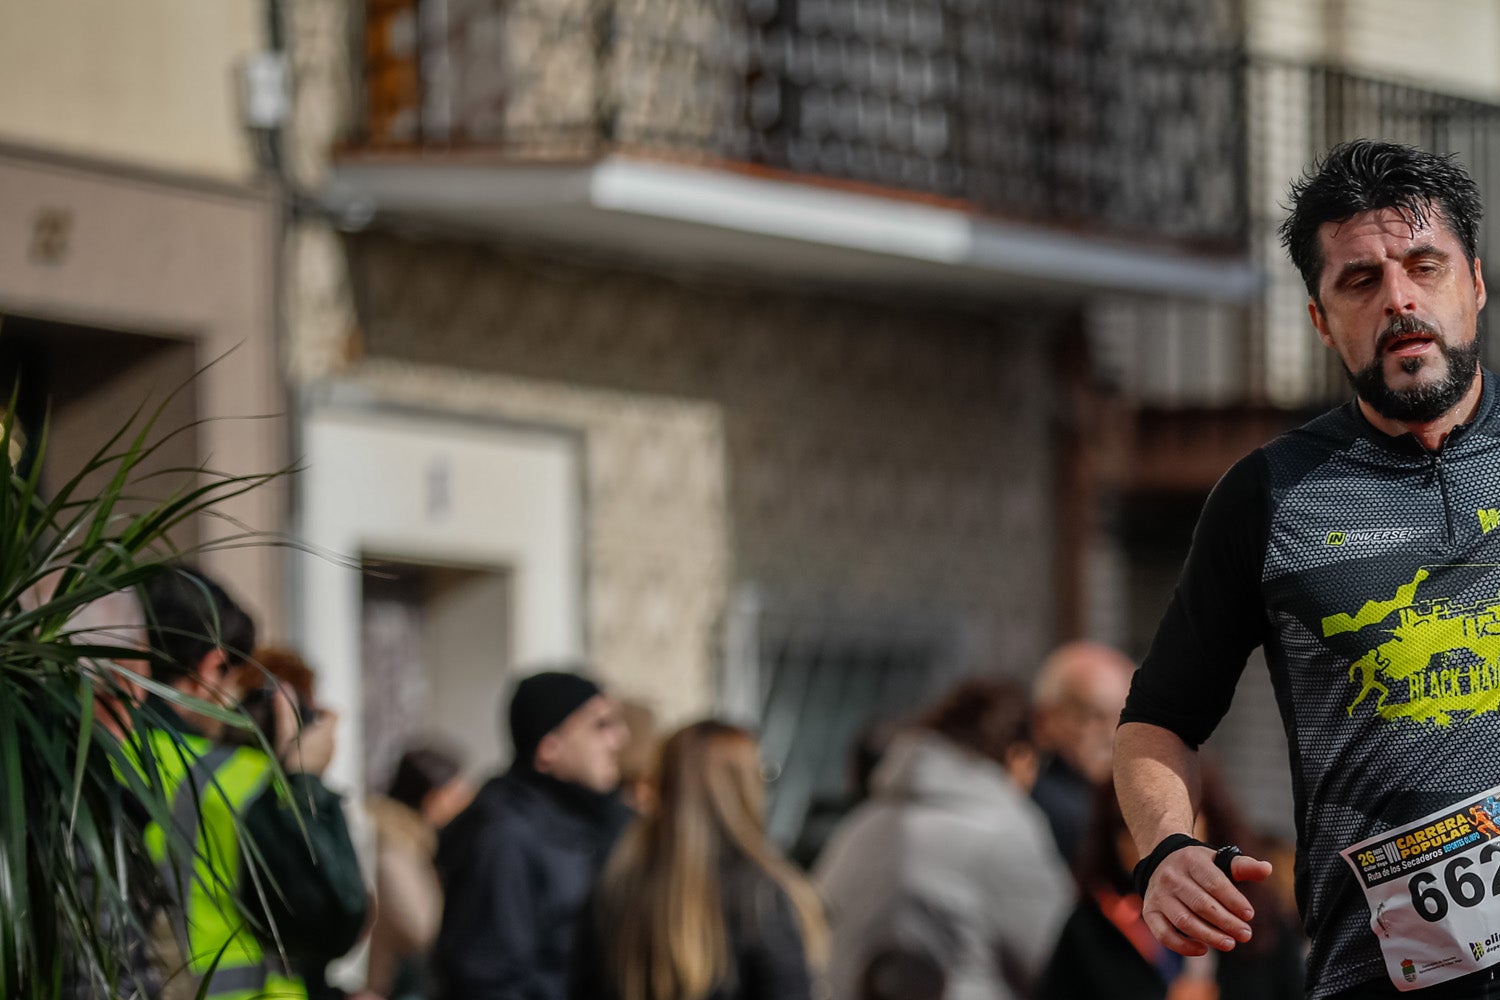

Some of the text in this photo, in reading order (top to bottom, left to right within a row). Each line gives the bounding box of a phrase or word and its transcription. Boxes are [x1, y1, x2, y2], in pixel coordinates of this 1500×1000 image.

[1351, 530, 1409, 542] INVERSE
[1409, 667, 1462, 701] BLACK
[1396, 813, 1469, 850] CARRERA
[1400, 824, 1472, 860] POPULAR
[1357, 851, 1376, 867] 26
[1367, 848, 1444, 882] Ruta de los Secaderos
